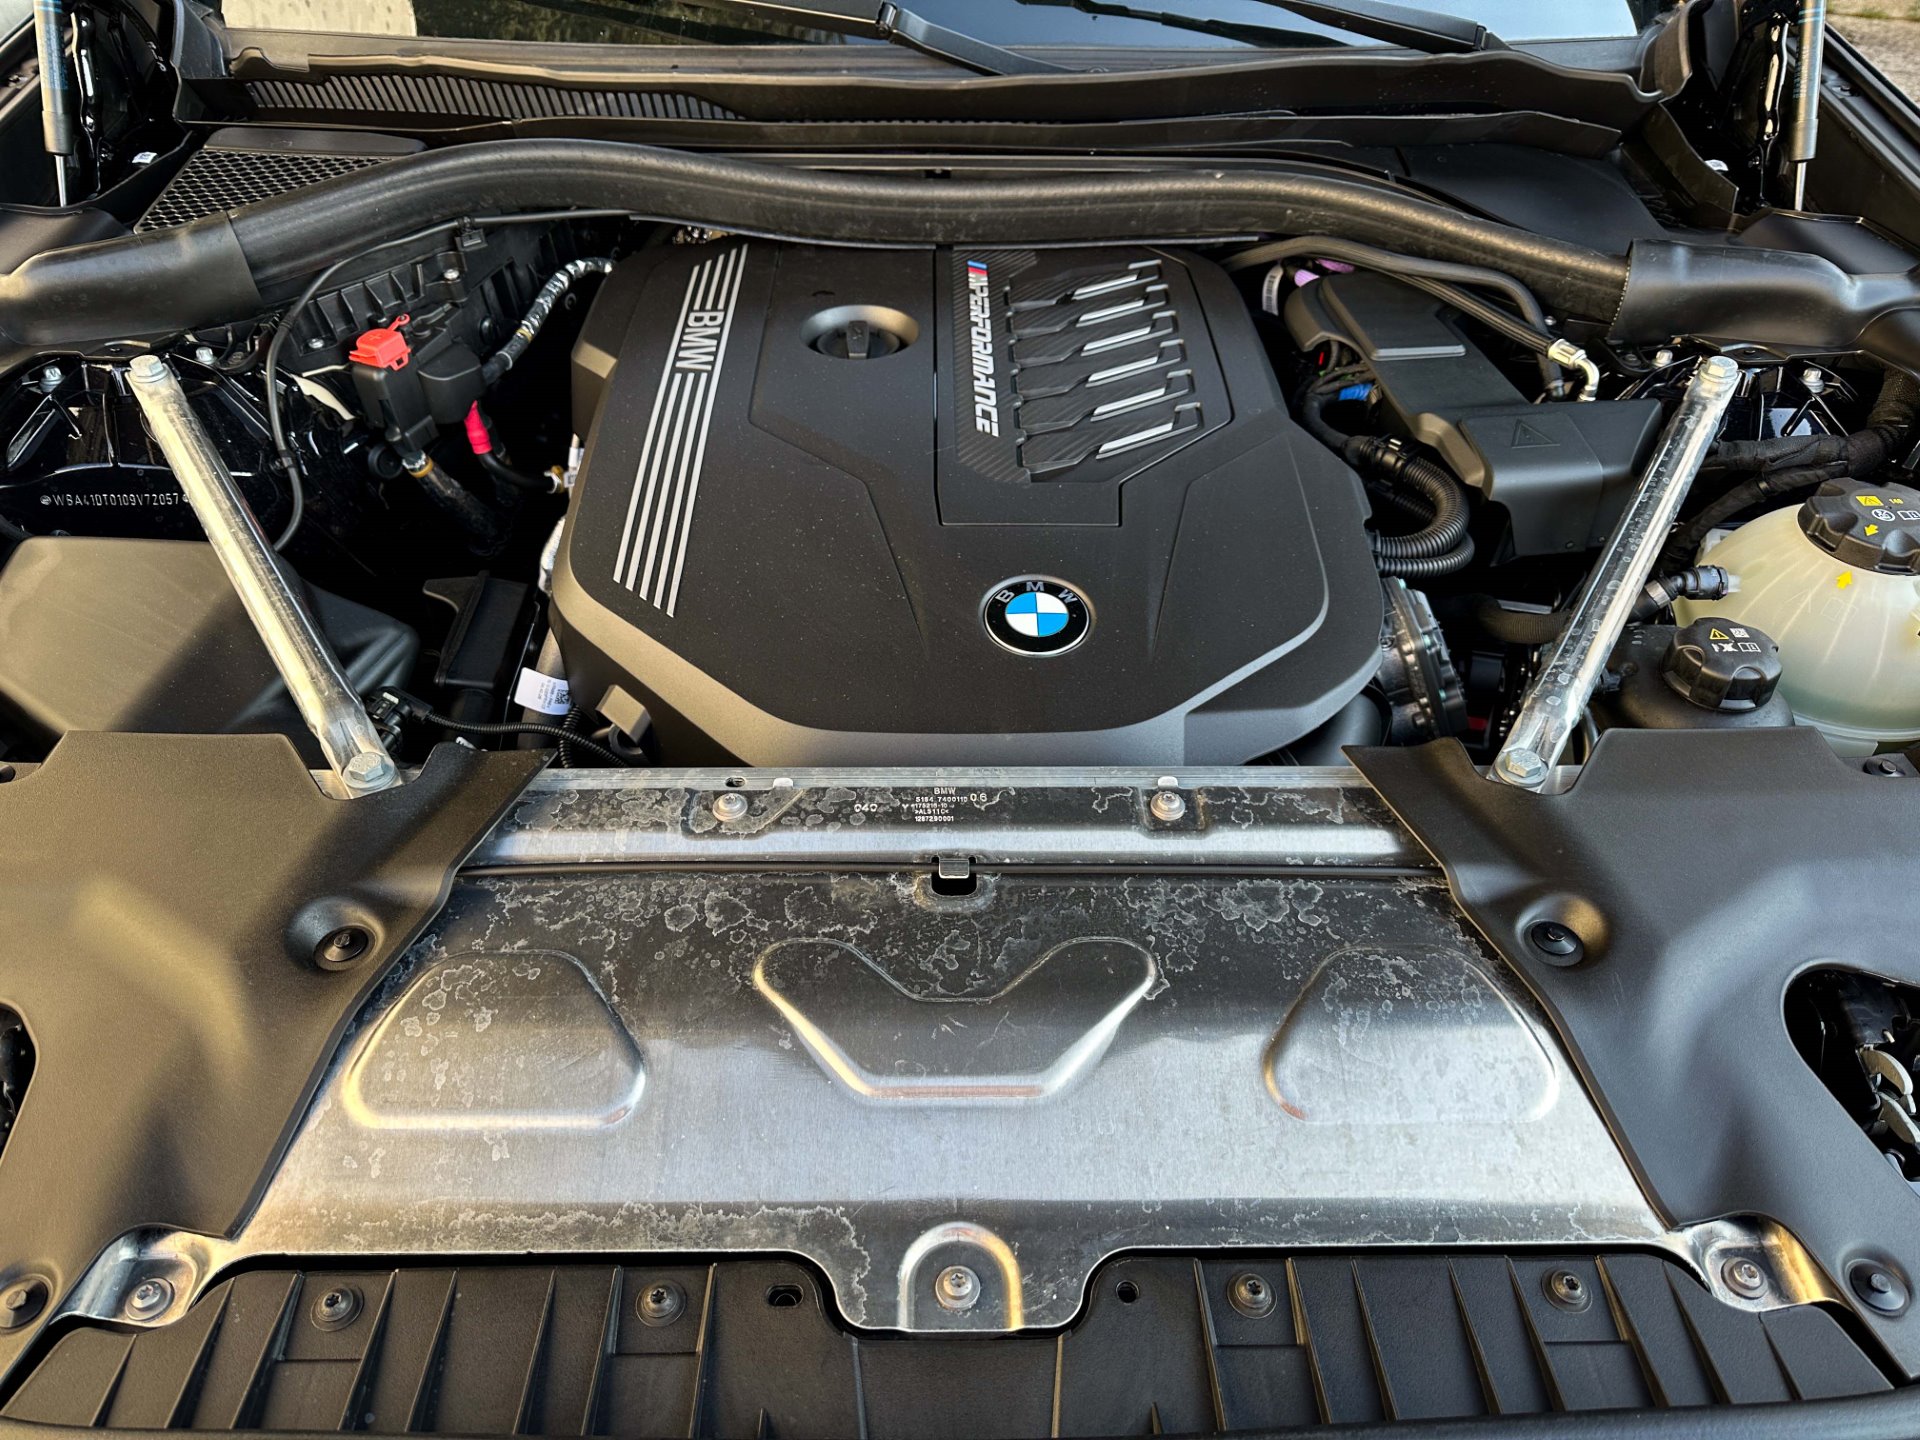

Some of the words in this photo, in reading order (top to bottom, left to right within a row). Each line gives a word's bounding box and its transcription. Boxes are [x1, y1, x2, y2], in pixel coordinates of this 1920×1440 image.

[675, 310, 725, 371] BMW
[995, 581, 1078, 604] BMW
[934, 787, 956, 795] BMW
